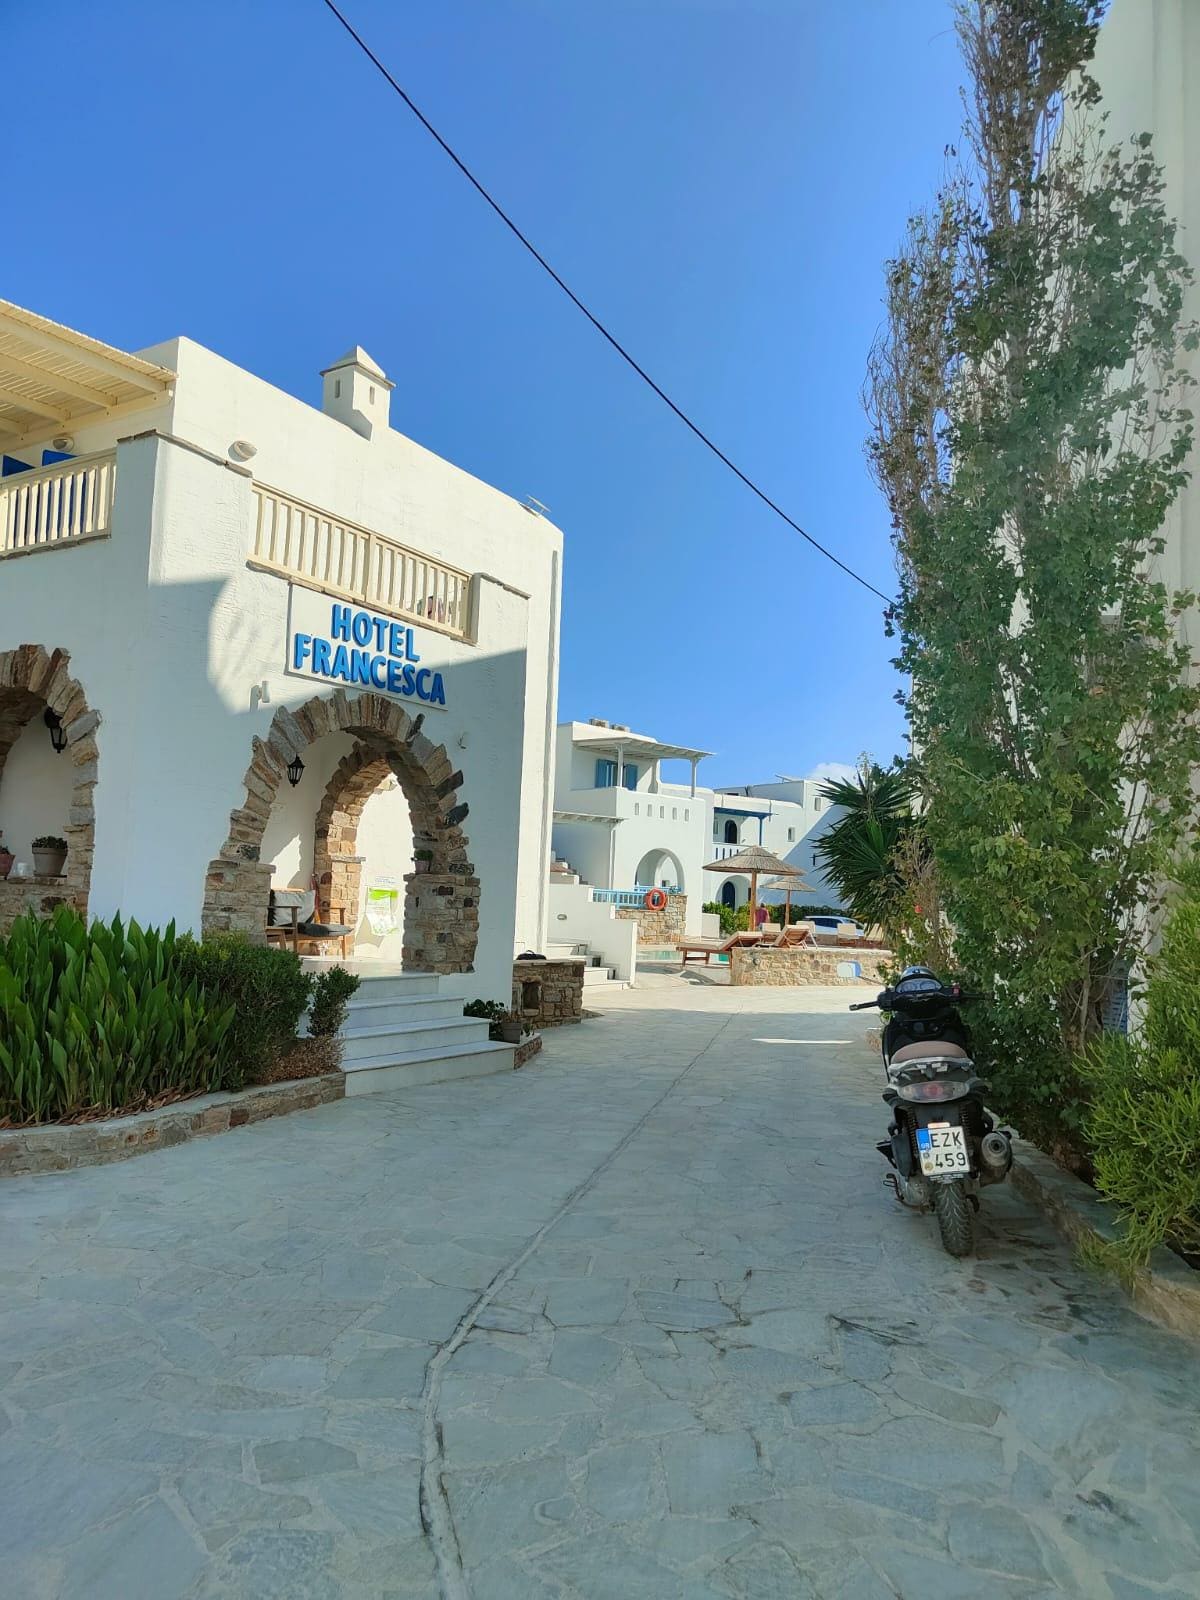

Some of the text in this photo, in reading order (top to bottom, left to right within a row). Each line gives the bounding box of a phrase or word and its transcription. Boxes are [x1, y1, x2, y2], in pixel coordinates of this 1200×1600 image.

[331, 604, 420, 662] HOTEL
[293, 633, 446, 705] FRANCESCA
[930, 1131, 962, 1148] EZK
[935, 1152, 966, 1168] 459
